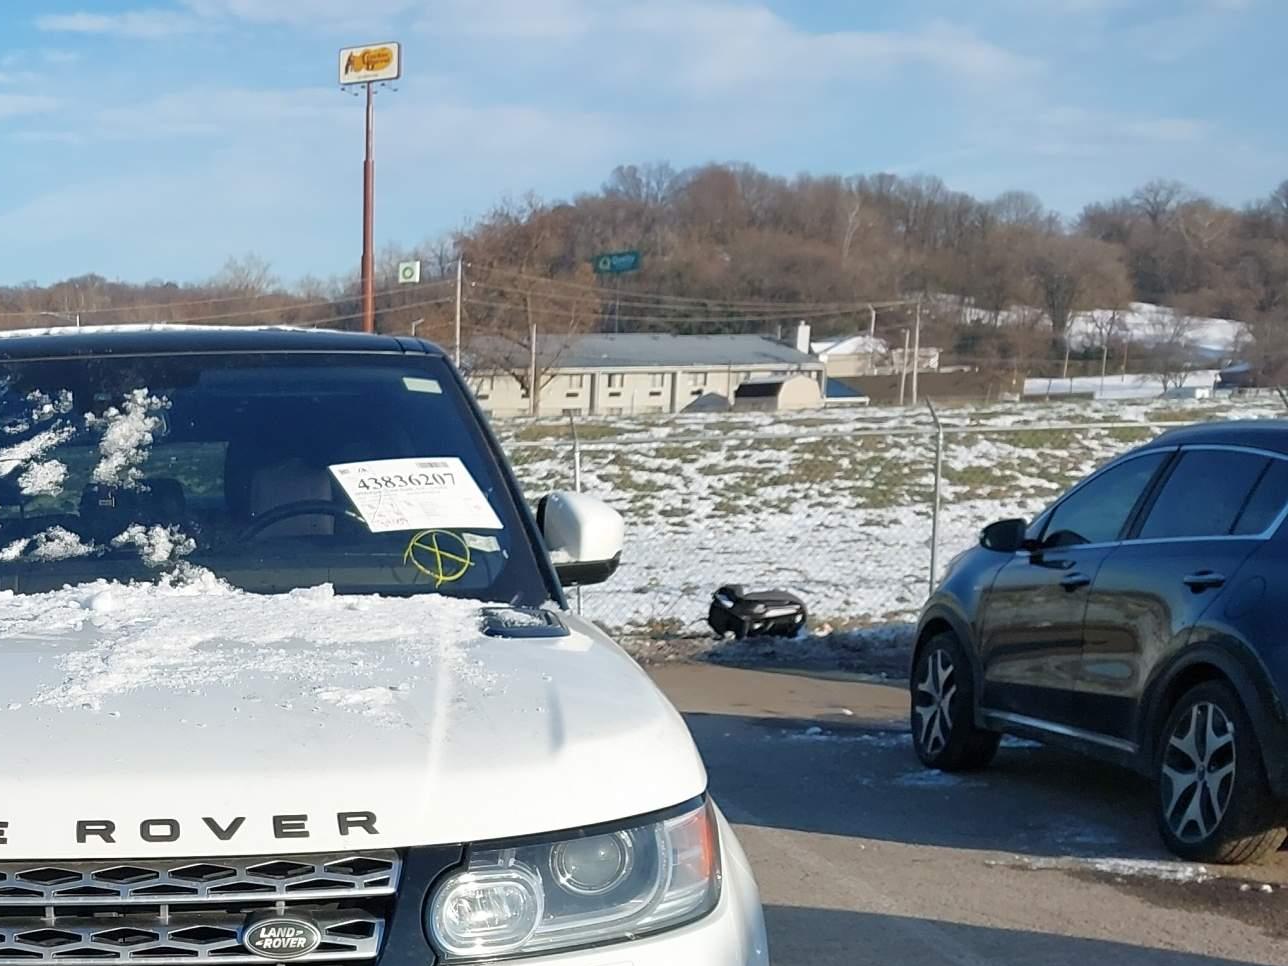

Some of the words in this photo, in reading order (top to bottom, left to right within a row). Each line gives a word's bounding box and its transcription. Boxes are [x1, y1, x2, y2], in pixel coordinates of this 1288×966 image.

[358, 472, 456, 490] 43836207
[76, 811, 379, 844] ROVER
[260, 927, 296, 939] LAND
[263, 937, 307, 949] ROVER
